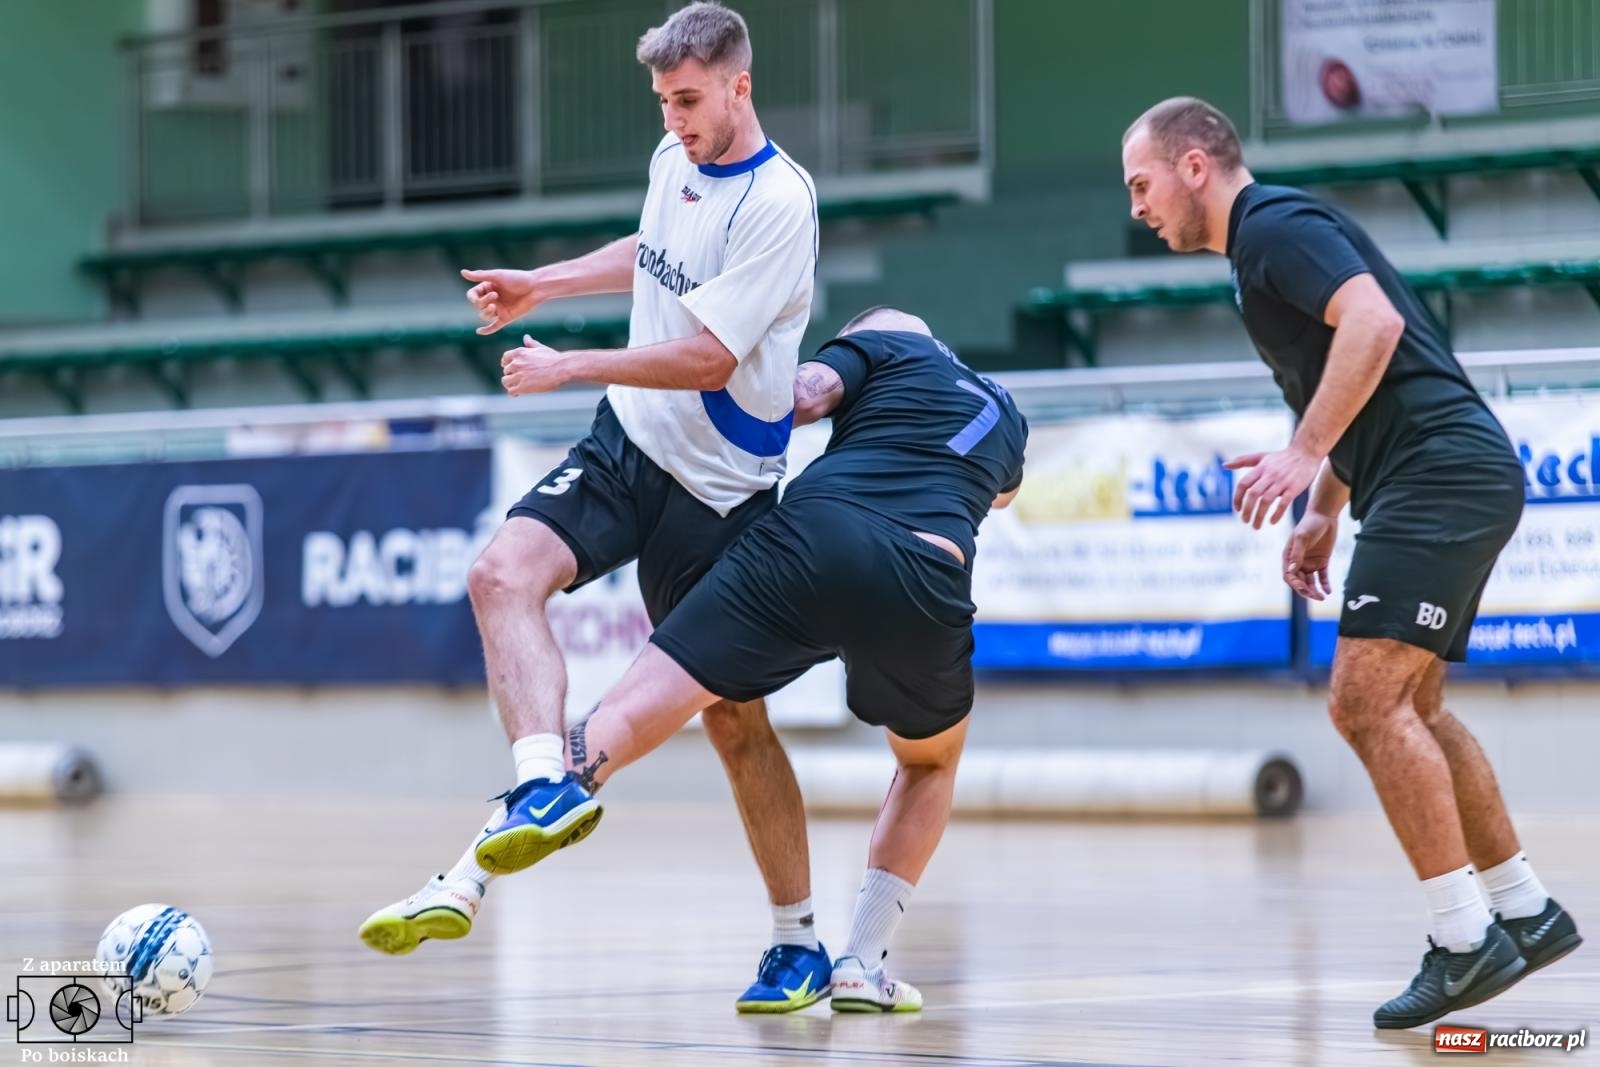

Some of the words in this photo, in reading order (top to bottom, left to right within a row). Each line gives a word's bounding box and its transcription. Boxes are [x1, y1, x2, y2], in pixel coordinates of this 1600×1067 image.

[536, 467, 584, 495] 3
[302, 527, 488, 607] RACIB
[1415, 601, 1448, 630] BD
